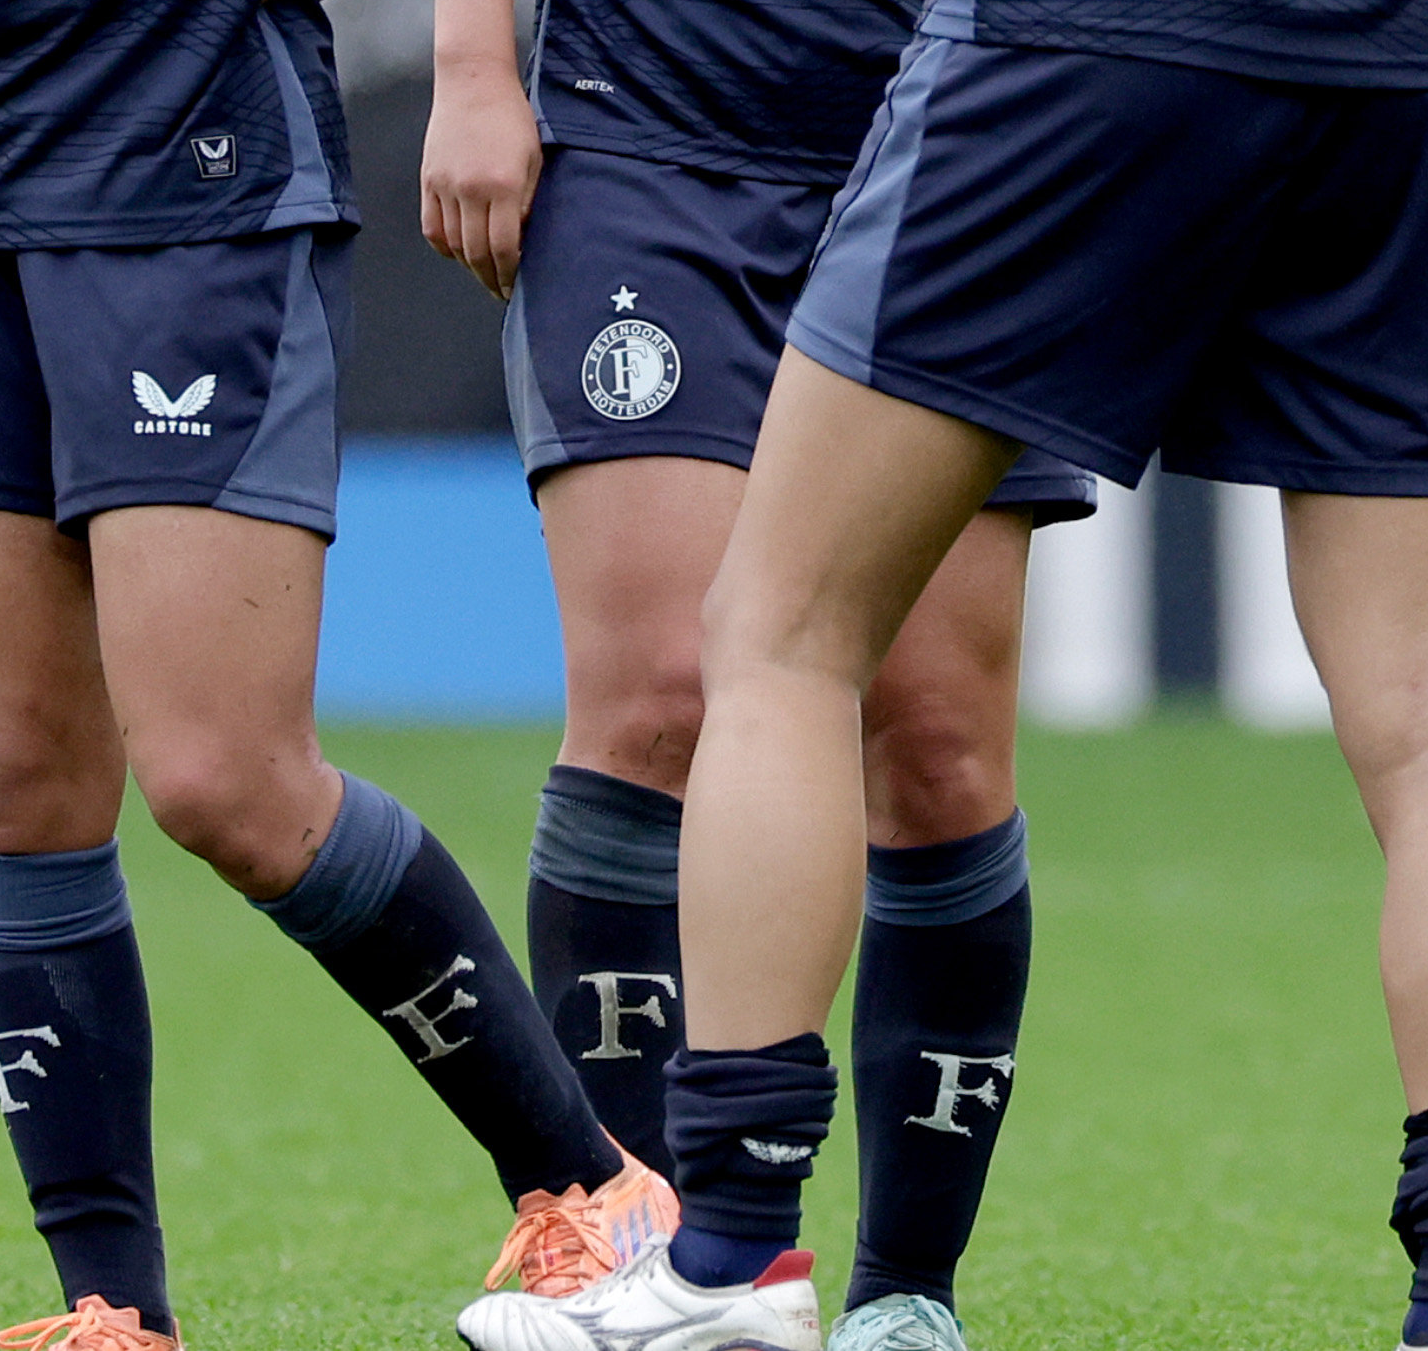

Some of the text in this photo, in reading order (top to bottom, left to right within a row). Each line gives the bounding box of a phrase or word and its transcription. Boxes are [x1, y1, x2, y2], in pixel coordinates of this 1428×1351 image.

[589, 324, 670, 362] FEYENOORD
[609, 346, 648, 395] F
[591, 380, 672, 416] ROTTERDAM
[133, 420, 212, 437] CASTORE
[385, 955, 478, 1063] F
[579, 971, 677, 1060] F
[904, 1051, 1016, 1137] F
